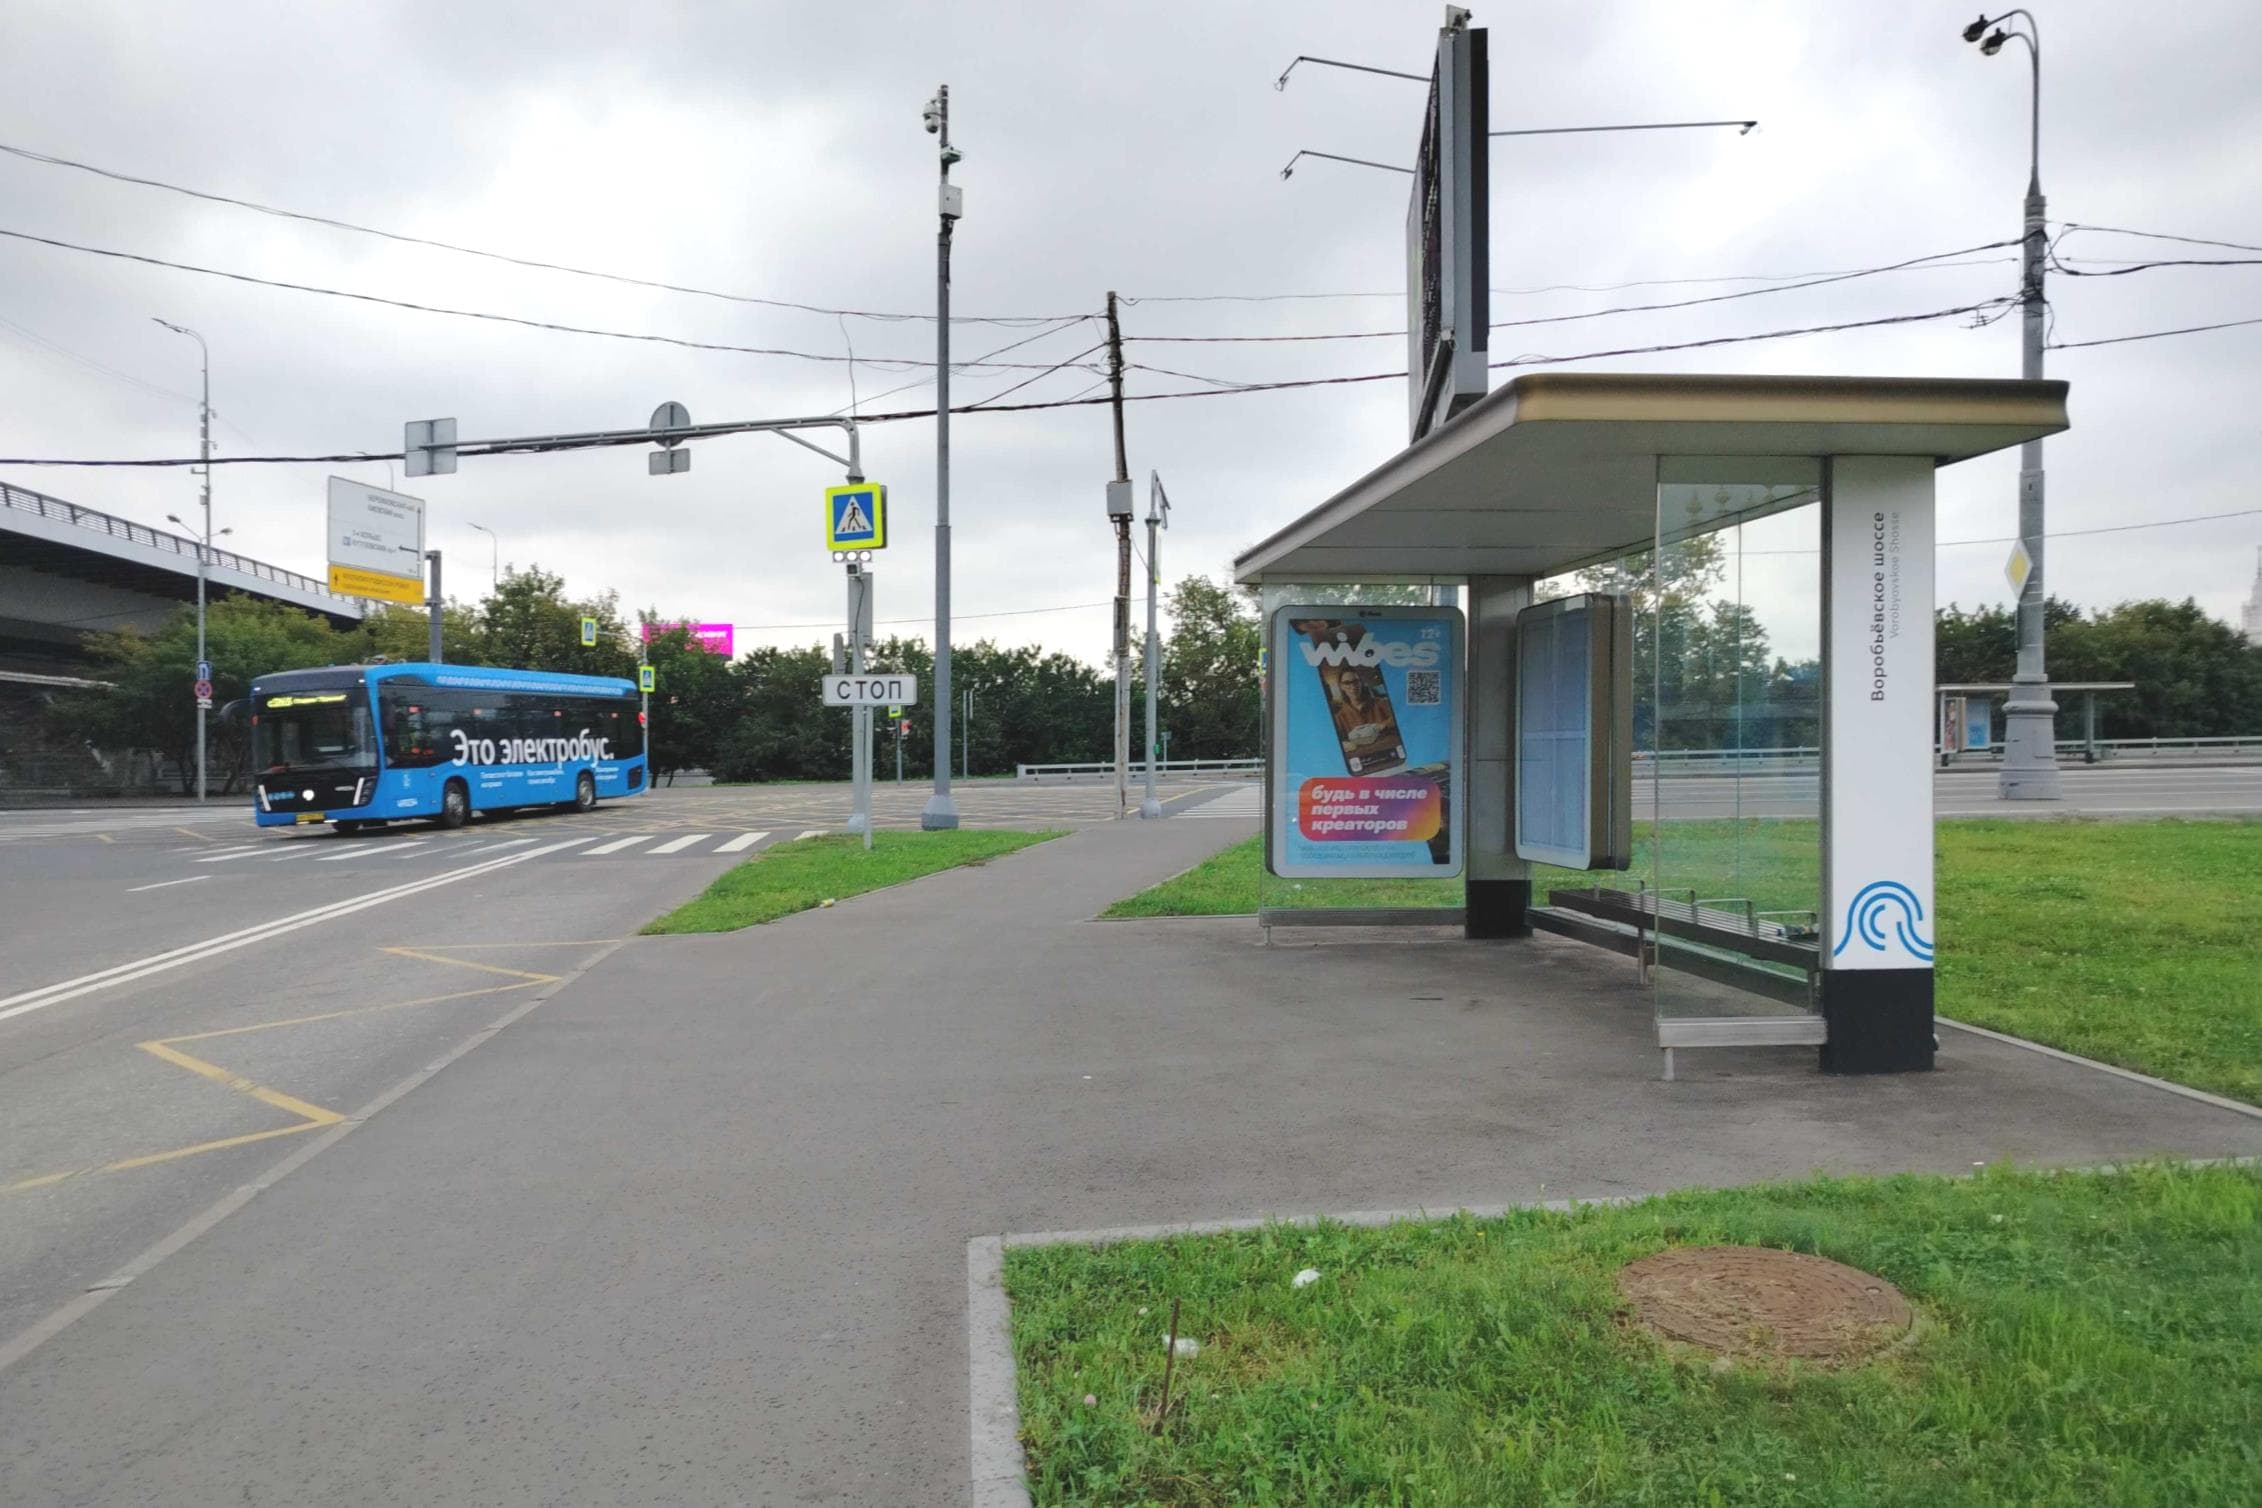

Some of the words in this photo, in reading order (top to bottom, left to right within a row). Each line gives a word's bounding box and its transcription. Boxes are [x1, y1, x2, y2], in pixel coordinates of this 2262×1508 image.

[1873, 511, 1885, 567] шоссе
[1300, 631, 1441, 668] vibes
[1870, 571, 1887, 702] Воробьёвское
[836, 680, 902, 700] СТОП
[450, 728, 496, 767] Это
[500, 728, 615, 769] электробус.
[1311, 784, 1355, 803] будь
[1358, 789, 1370, 800] в
[1374, 789, 1428, 800] числе
[1311, 804, 1380, 819] первых
[1311, 819, 1409, 834] креаторов
